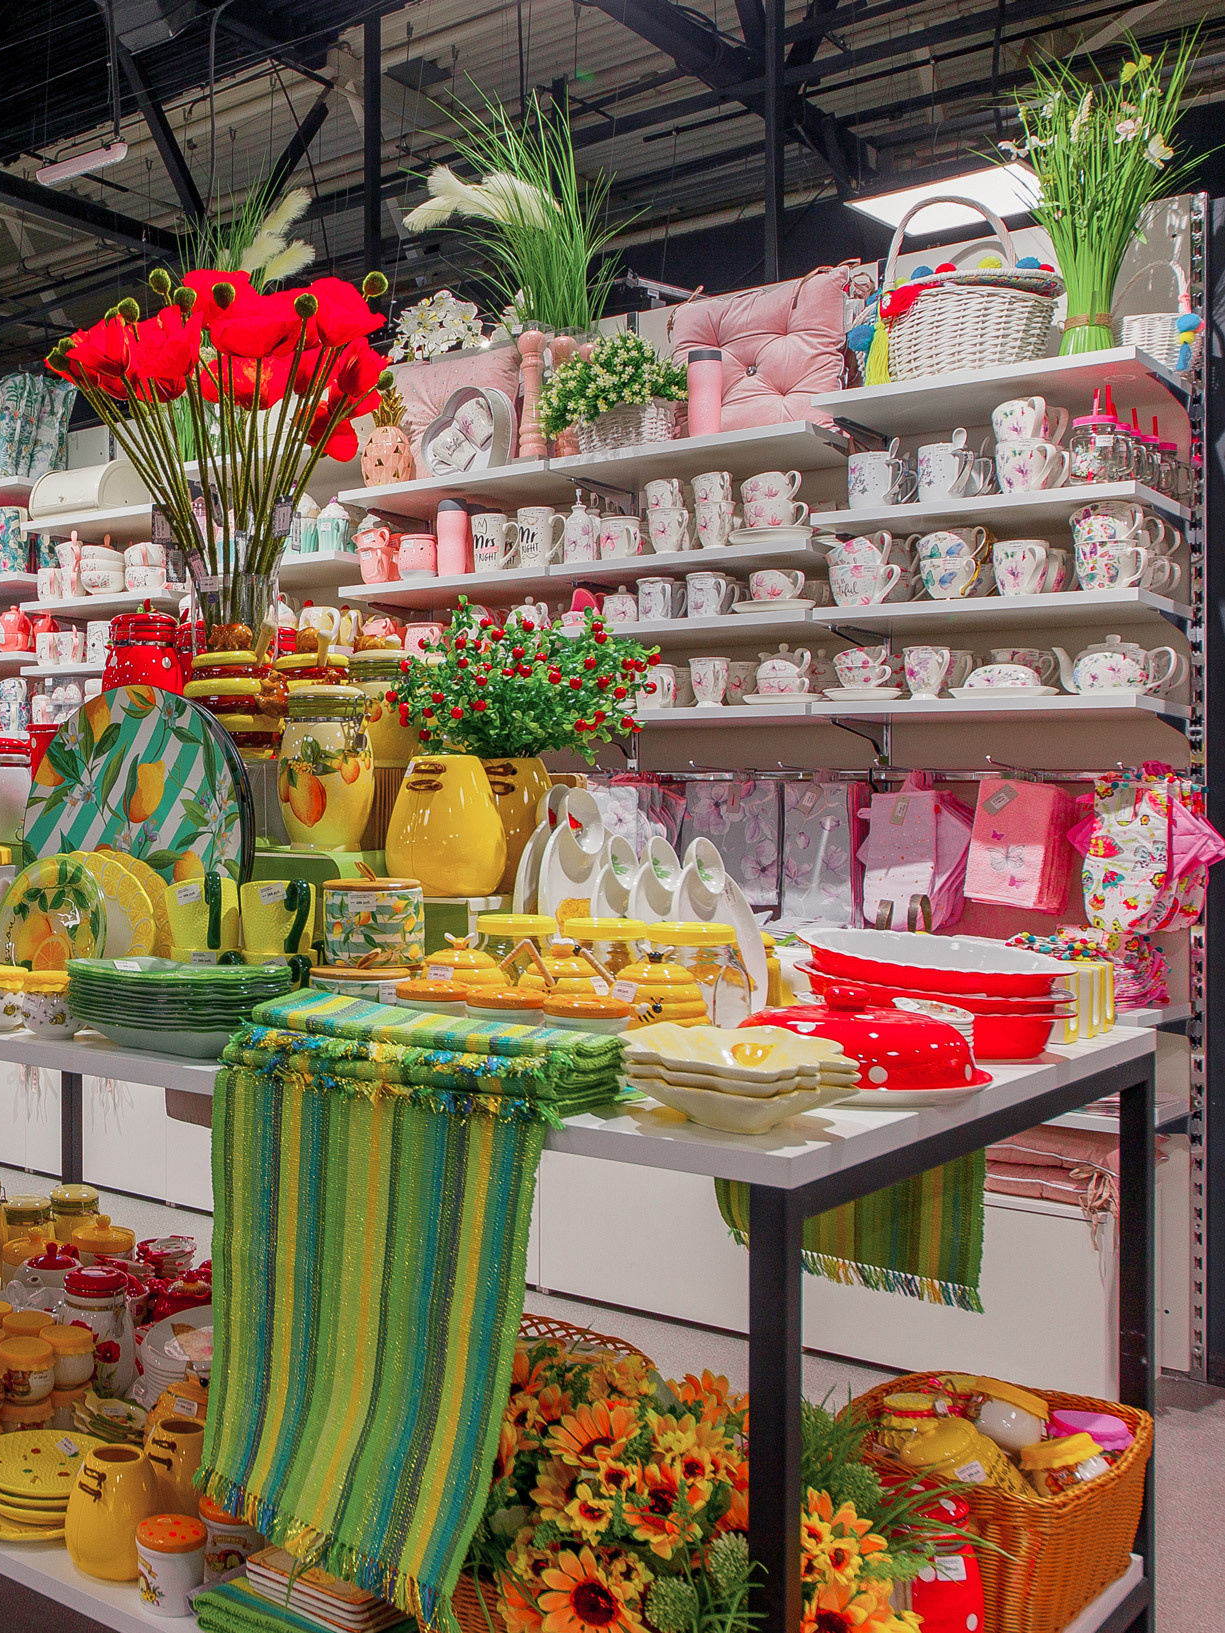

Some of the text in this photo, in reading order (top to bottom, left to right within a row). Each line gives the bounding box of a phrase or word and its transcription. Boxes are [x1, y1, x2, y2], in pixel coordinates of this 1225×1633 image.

[519, 525, 538, 544] Mr
[473, 534, 496, 549] Mrs
[521, 542, 539, 554] RIGHT
[478, 551, 497, 562] RIGHT
